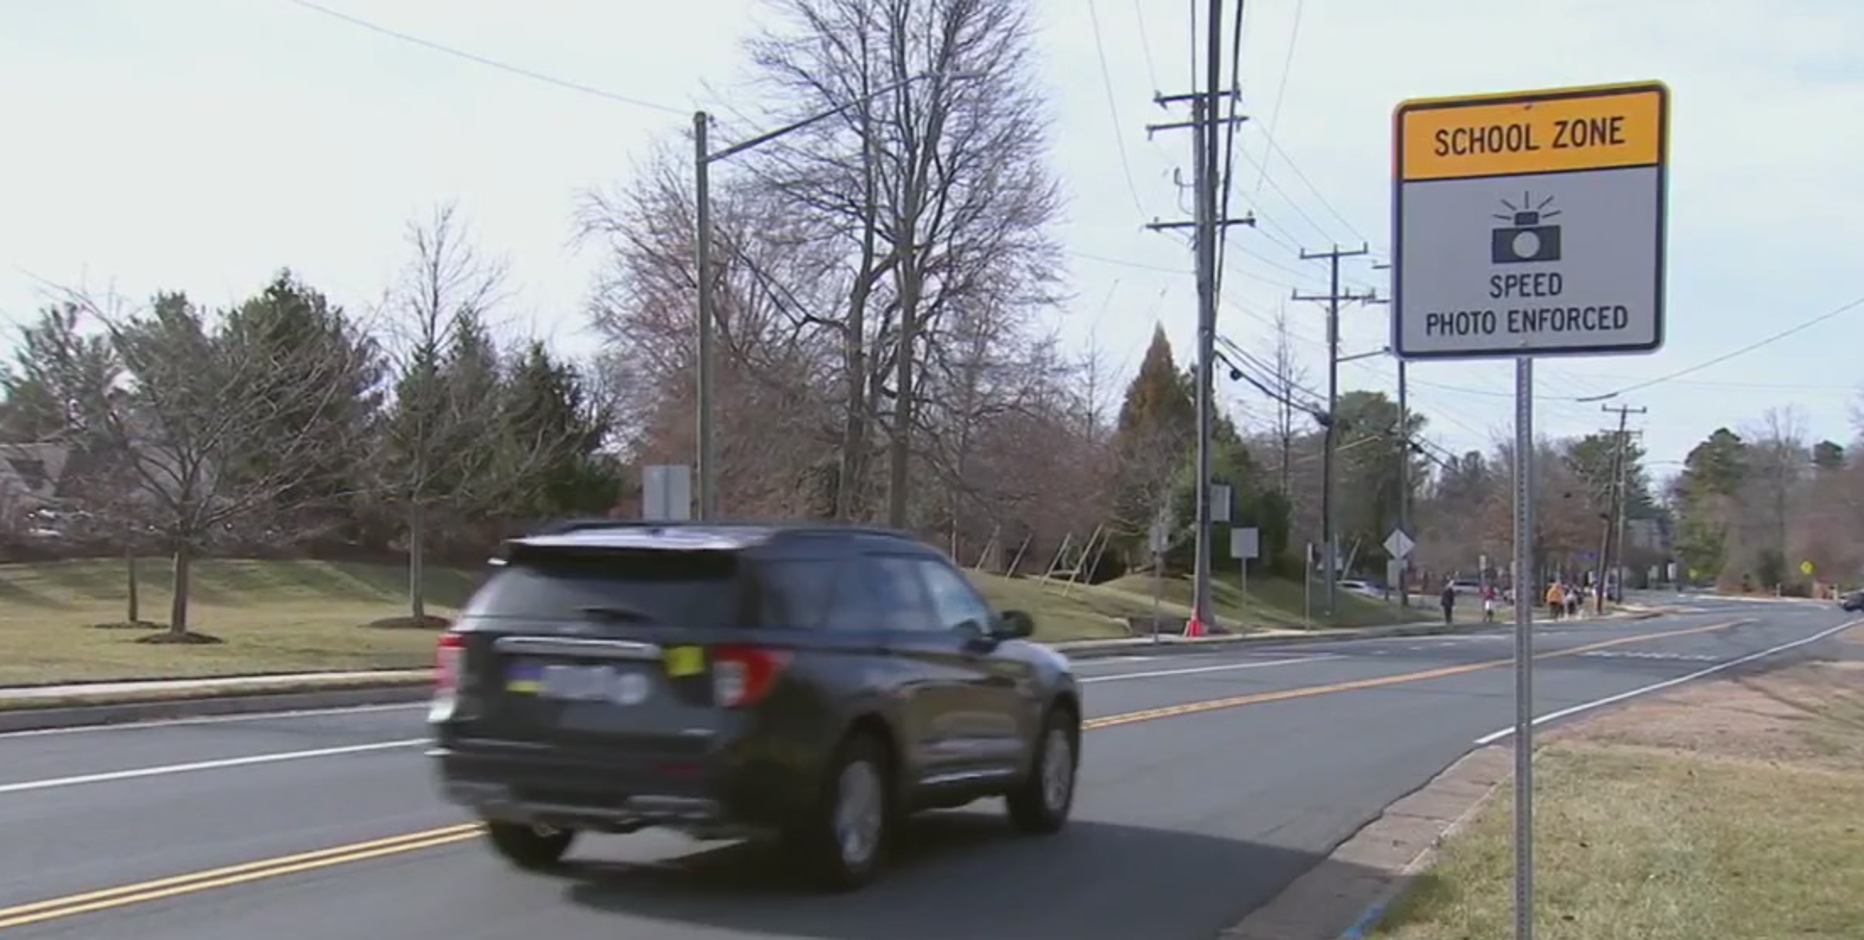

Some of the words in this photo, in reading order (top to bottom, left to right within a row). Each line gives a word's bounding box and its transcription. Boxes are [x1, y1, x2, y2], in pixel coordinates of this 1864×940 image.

[1434, 123, 1540, 157] SCHOOL
[1552, 116, 1626, 149] ZONE
[1489, 272, 1563, 299] SPEED
[1426, 310, 1496, 336] PHOTO
[1507, 305, 1628, 334] ENFORCED
